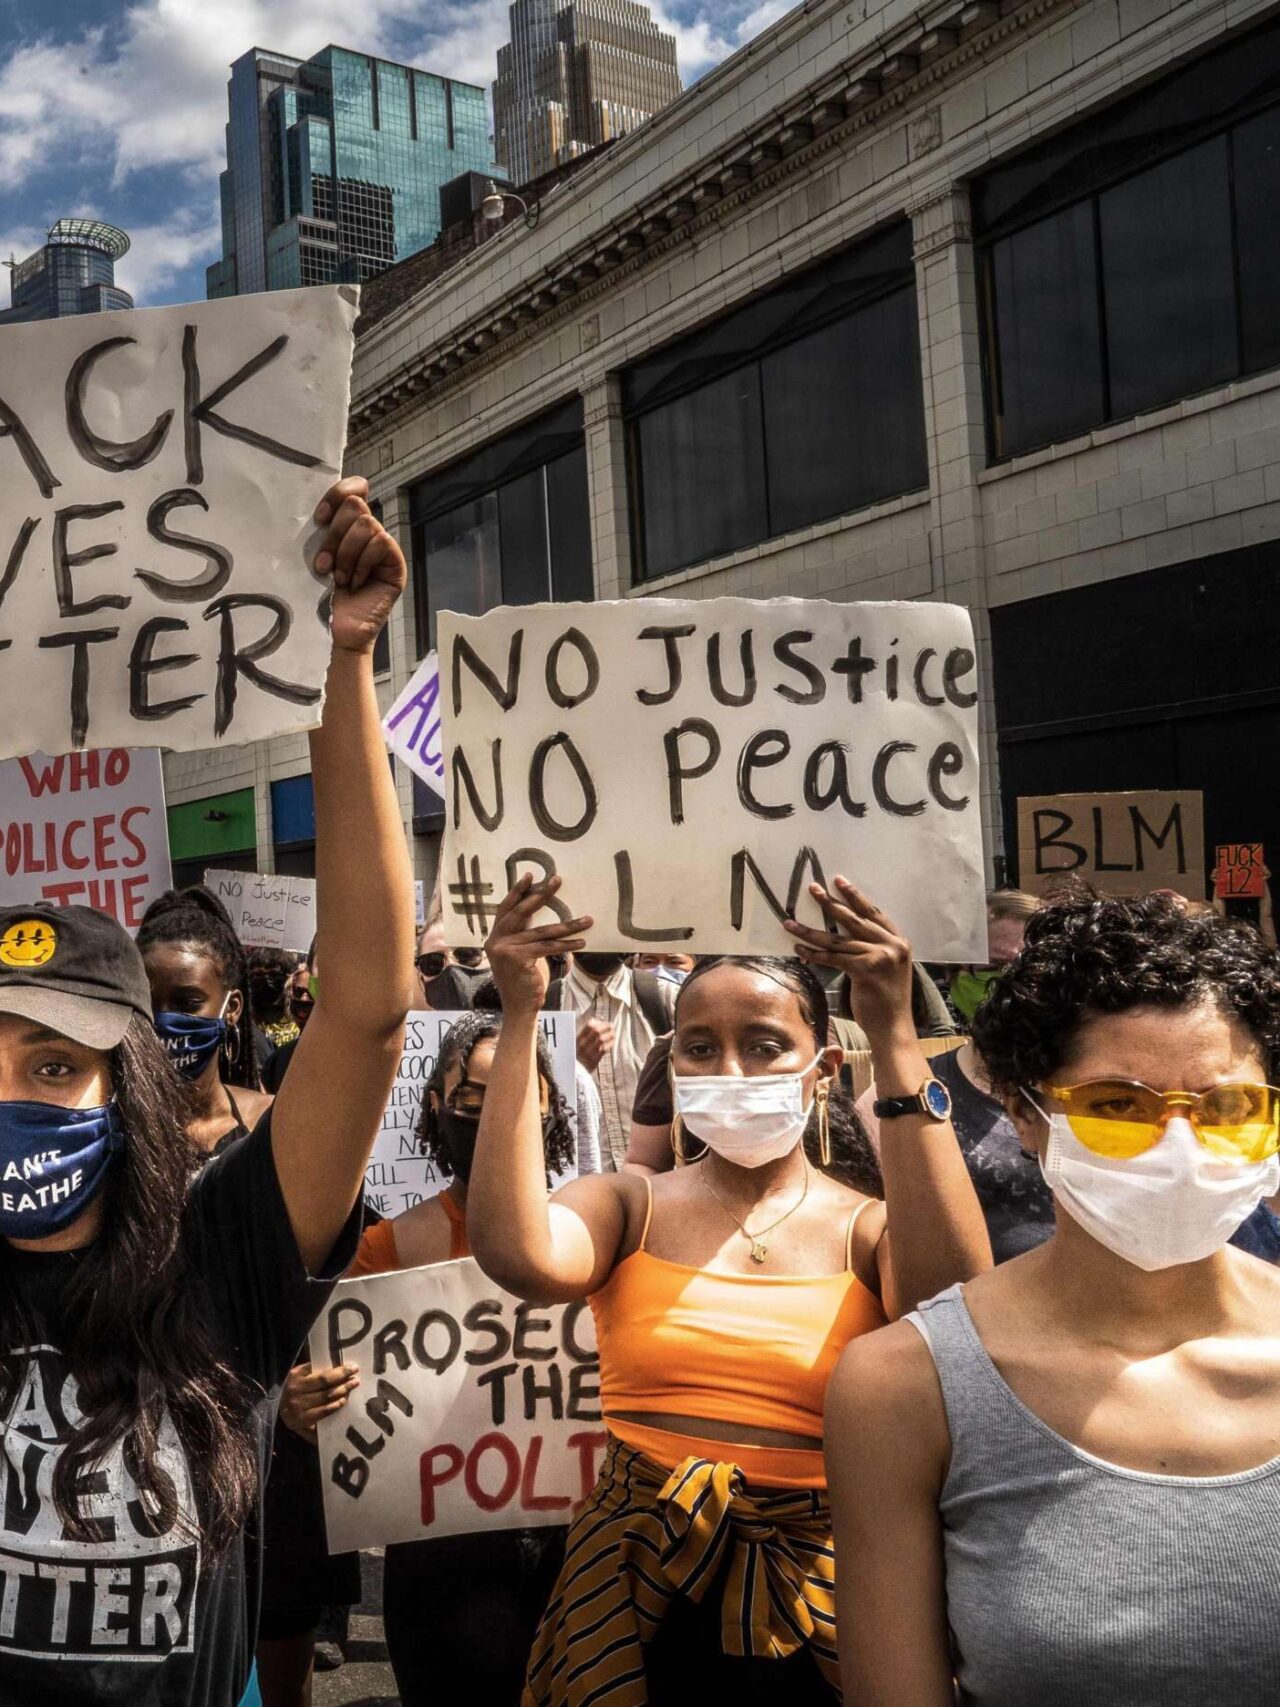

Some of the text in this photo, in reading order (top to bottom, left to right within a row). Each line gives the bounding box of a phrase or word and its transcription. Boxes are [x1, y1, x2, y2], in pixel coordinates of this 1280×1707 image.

[453, 627, 601, 718] NO
[18, 747, 130, 797] WHO
[453, 717, 970, 842] NO Peace
[1033, 803, 1187, 875] BLM
[1218, 845, 1261, 868] FUCK
[42, 874, 149, 927] THE
[219, 882, 311, 906] NO Justice
[1224, 867, 1253, 894] 12
[241, 911, 285, 932] Peace
[477, 1362, 602, 1426] THE
[331, 1378, 413, 1499] BLM
